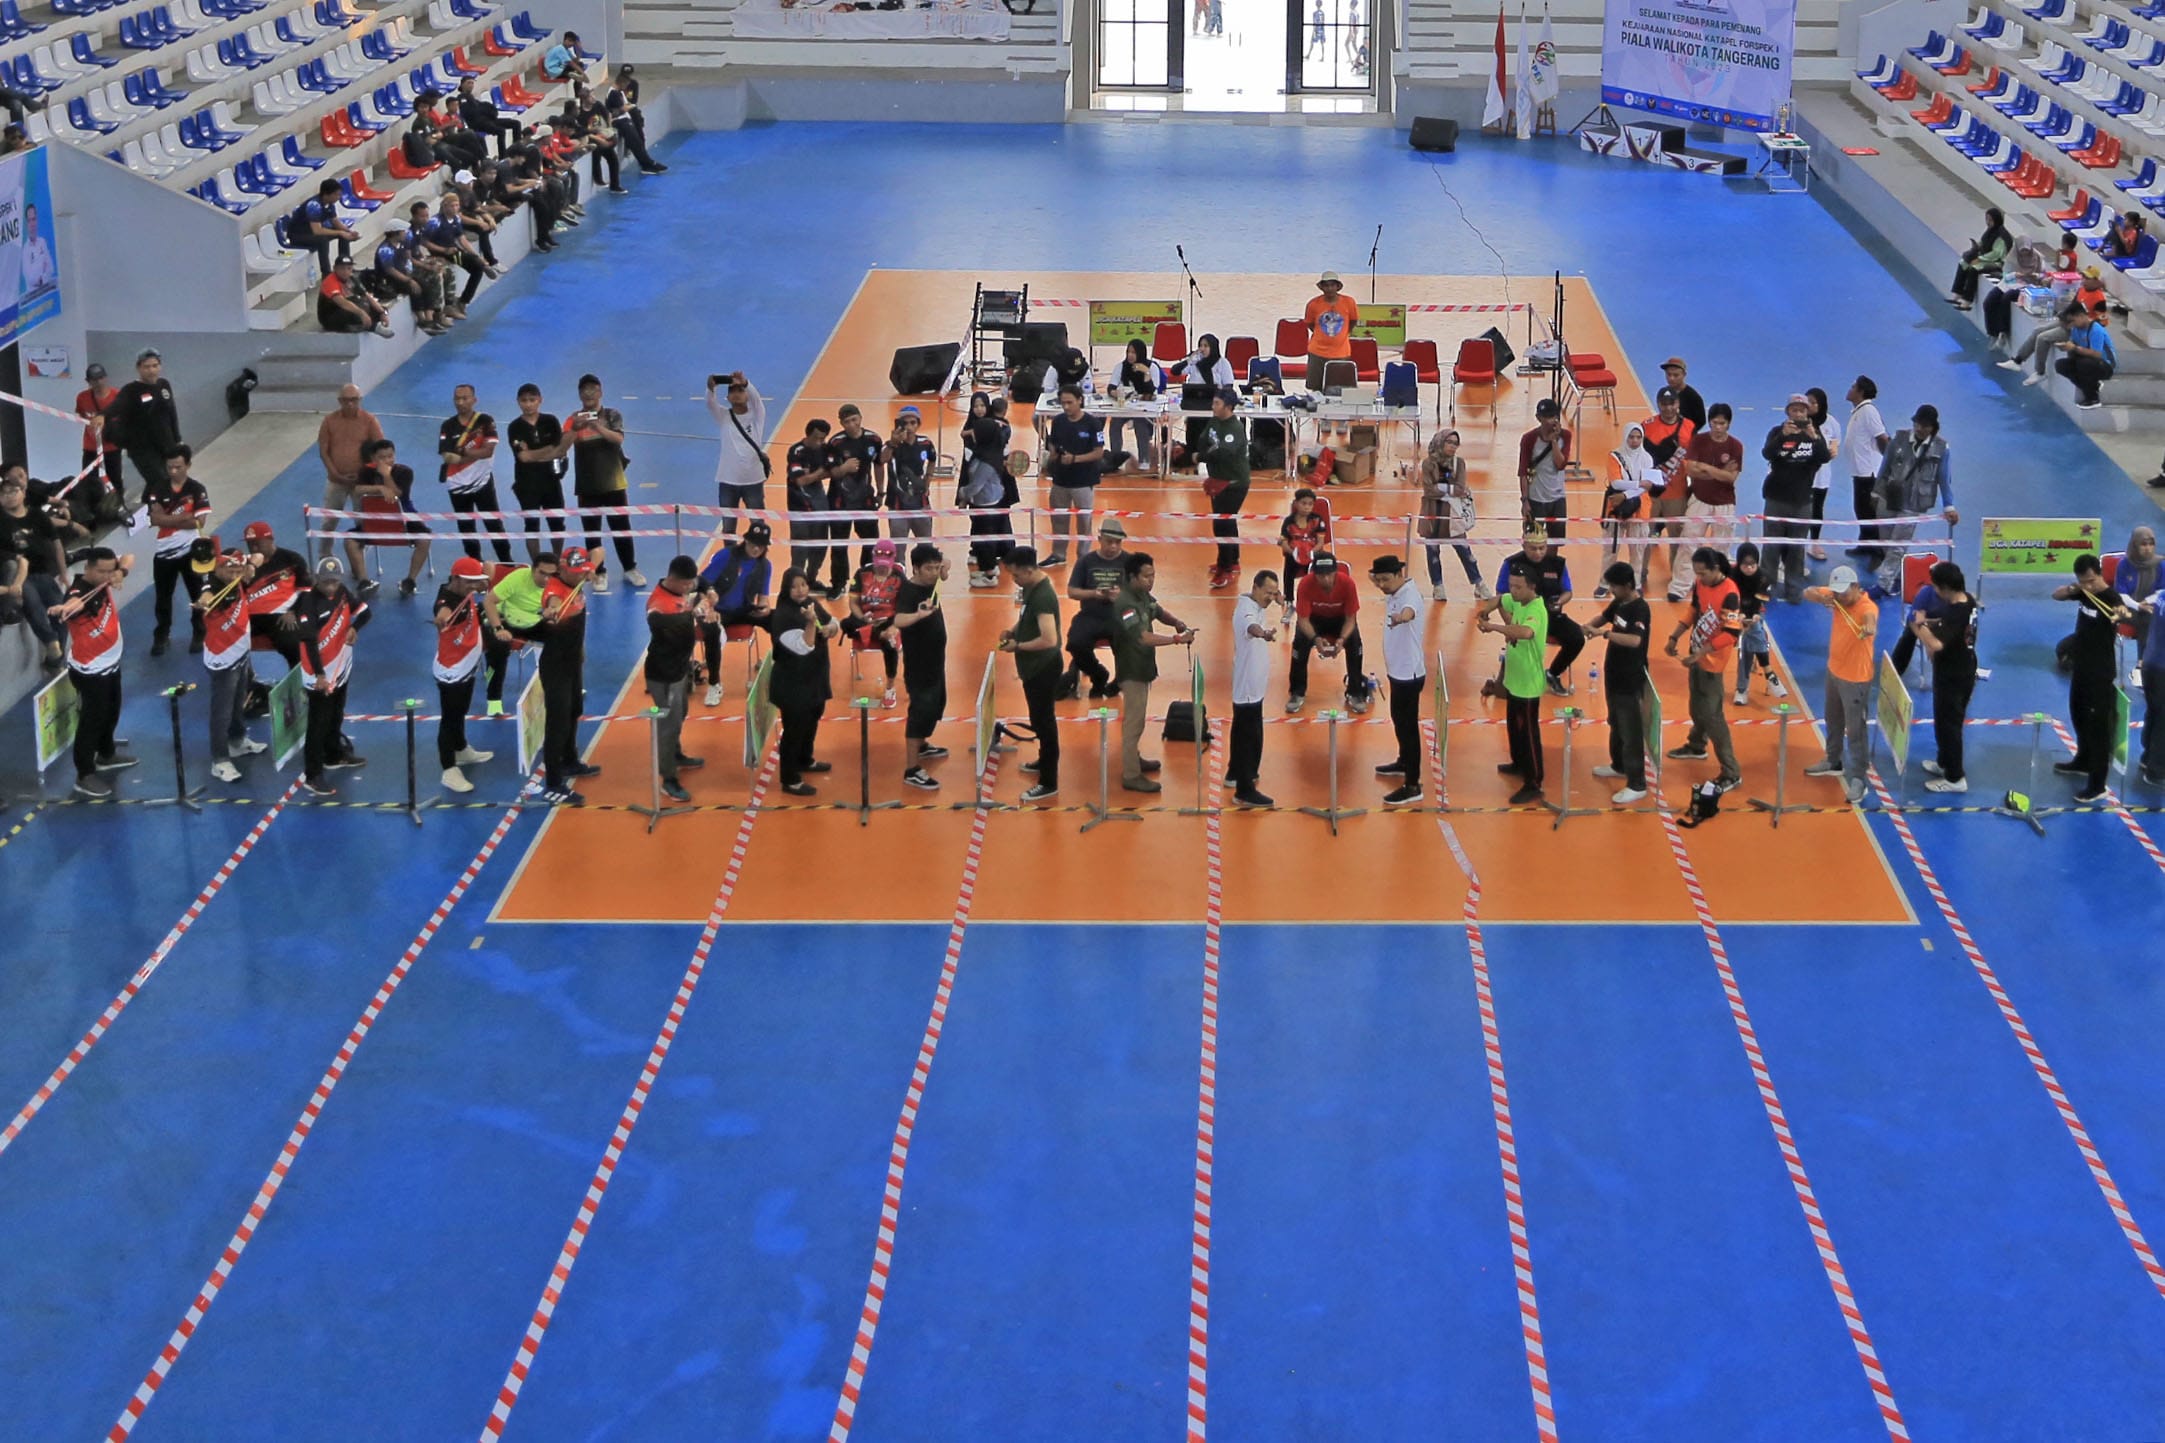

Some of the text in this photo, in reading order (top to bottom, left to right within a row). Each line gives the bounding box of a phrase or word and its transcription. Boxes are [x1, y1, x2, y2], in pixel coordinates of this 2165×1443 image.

[1639, 8, 1671, 21] SELAMAT
[1672, 13, 1700, 25] KEPADA
[1700, 18, 1720, 29] PARA
[1721, 21, 1761, 35] PEMENANG
[1622, 20, 1666, 34] KEJUARAAN
[1667, 27, 1703, 41] NASIONAL
[1704, 34, 1737, 47] KATAPEL
[1739, 39, 1775, 53] FORSPEK
[1621, 31, 1780, 71] PIALA WALIKOTA TANGERANG
[1597, 136, 1604, 148] 2
[1687, 158, 1696, 168] 3
